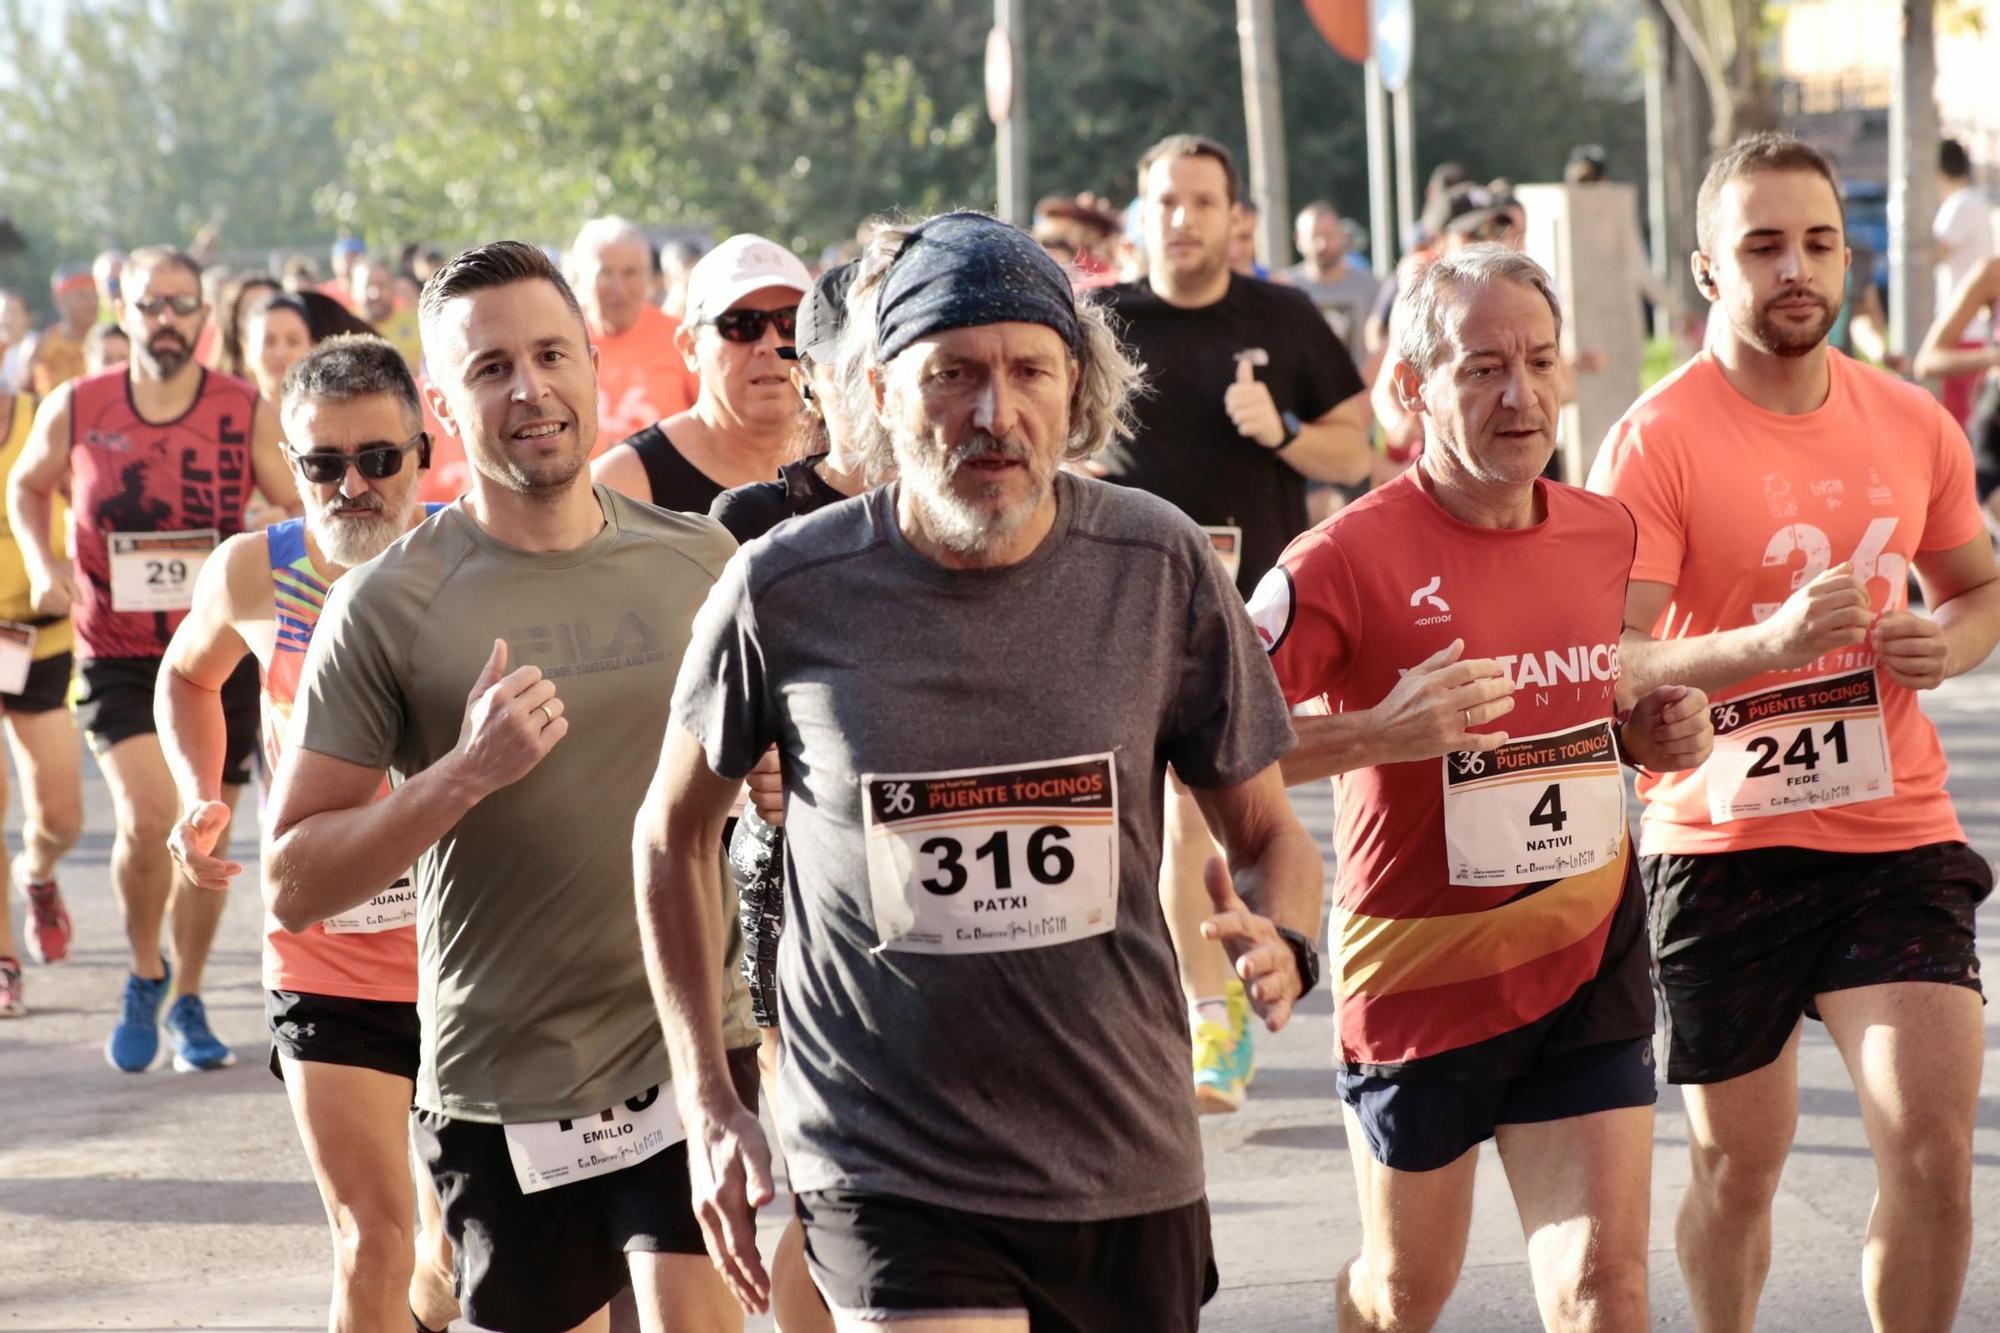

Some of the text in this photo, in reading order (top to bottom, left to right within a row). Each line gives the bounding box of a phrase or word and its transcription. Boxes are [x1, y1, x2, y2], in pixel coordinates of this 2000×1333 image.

[145, 561, 187, 585] 29
[1749, 695, 1807, 719] PUENTE
[1810, 681, 1870, 706] TOCINOS
[1497, 733, 1609, 770] PUENTE TOCINOS
[1745, 720, 1848, 779] 241
[929, 774, 1103, 809] PUENTE TOCINOS
[1786, 774, 1820, 787] FEDE
[1529, 783, 1567, 832] 4
[919, 825, 1075, 896] 316
[1526, 835, 1572, 851] NATIVI
[973, 896, 1027, 912] PATXI
[582, 1123, 633, 1144] EMILIO
